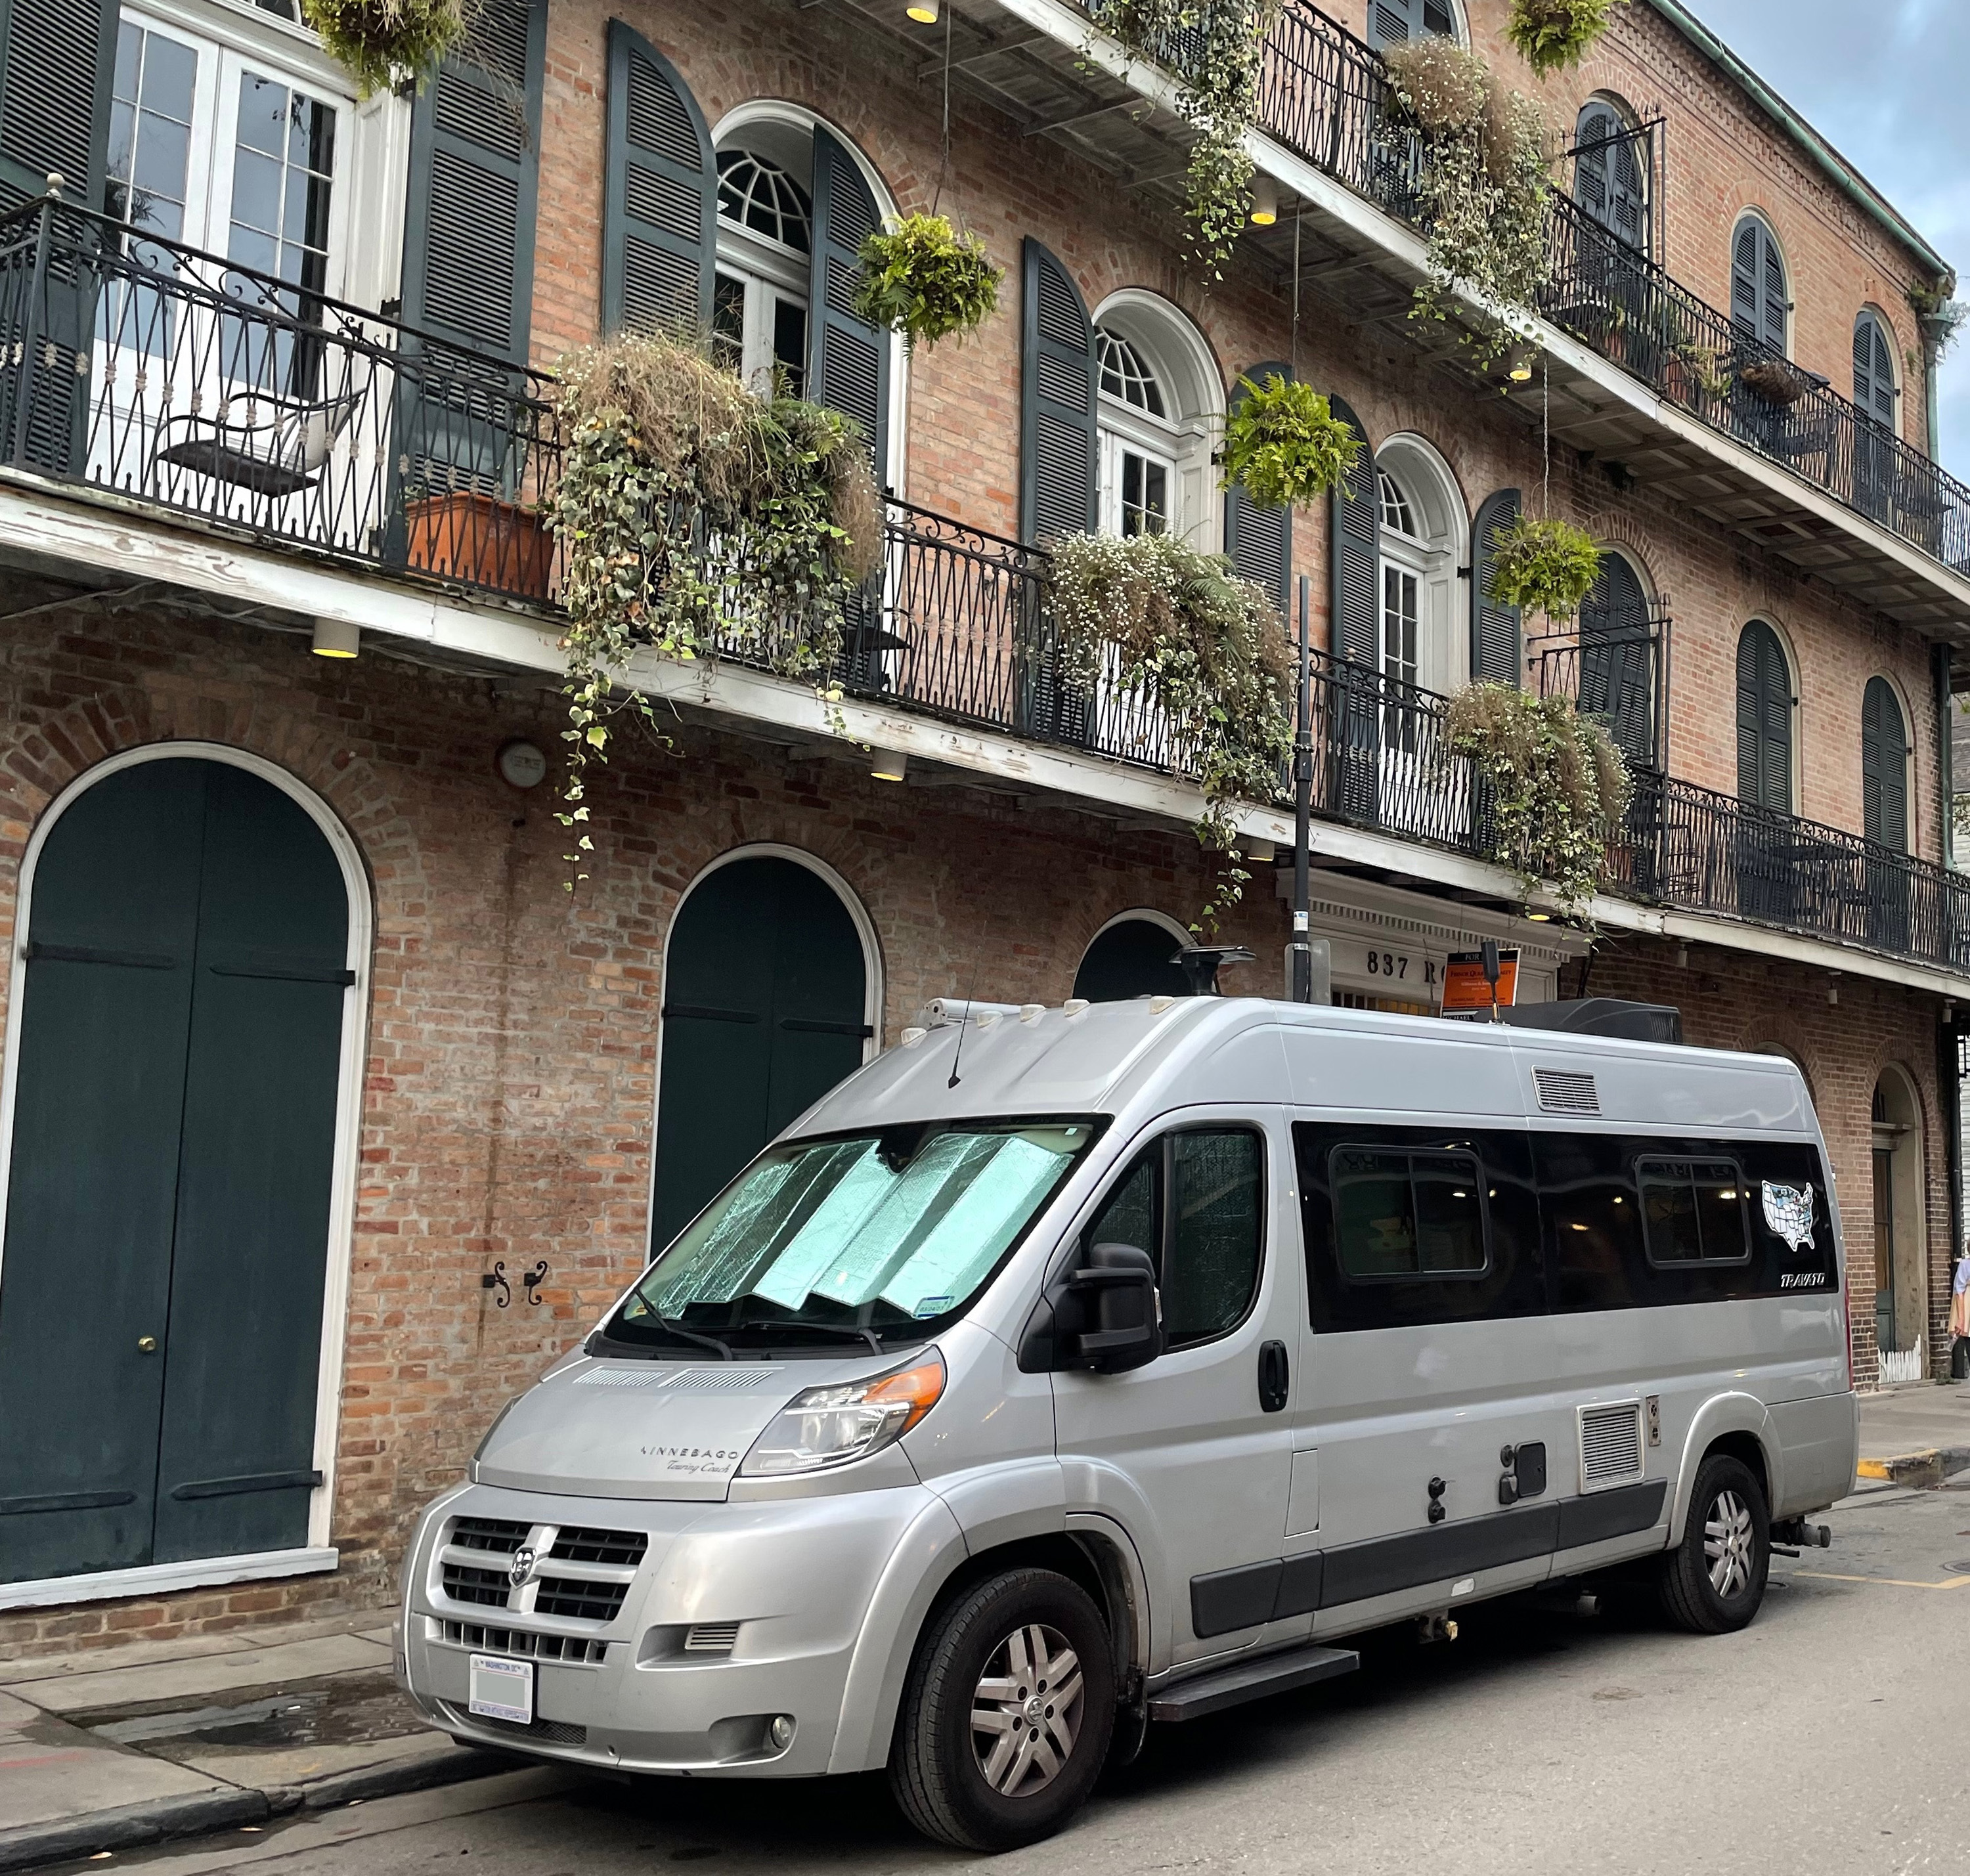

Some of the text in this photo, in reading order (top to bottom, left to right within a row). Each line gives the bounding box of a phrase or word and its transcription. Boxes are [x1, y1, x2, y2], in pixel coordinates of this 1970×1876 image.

[1367, 951, 1409, 979] 837
[1780, 1273, 1826, 1288] TRAVATO
[667, 1460, 732, 1474] Touring Coach
